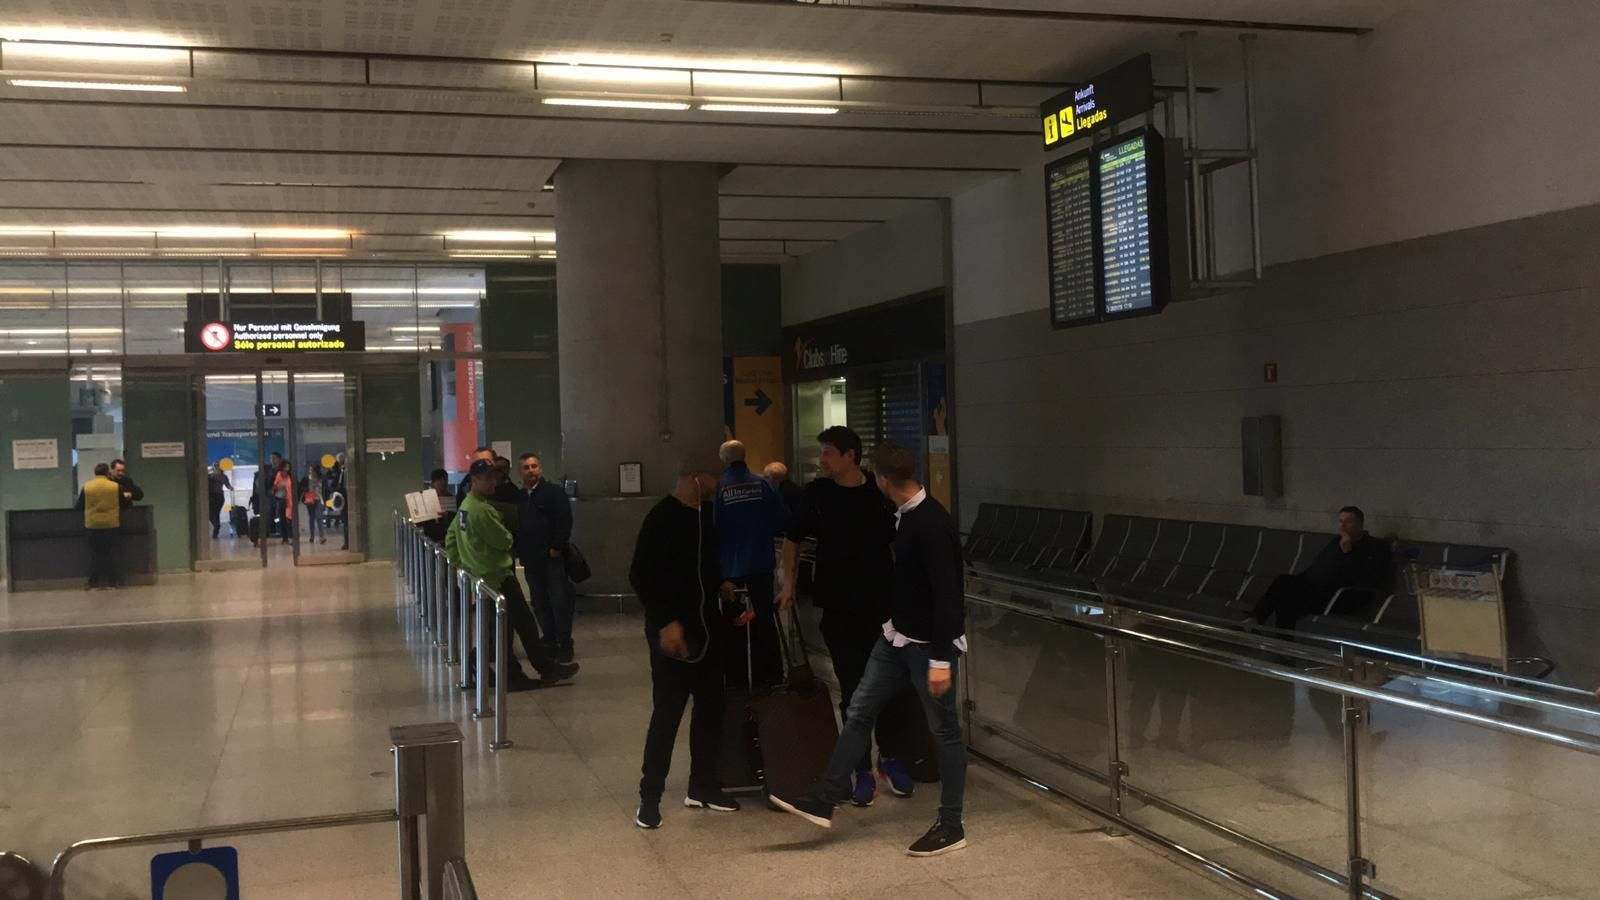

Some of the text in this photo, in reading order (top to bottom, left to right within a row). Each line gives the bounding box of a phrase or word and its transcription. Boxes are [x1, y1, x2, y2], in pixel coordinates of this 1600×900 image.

[1074, 84, 1094, 101] Ankunft
[1075, 99, 1095, 115] Arrivals
[1076, 110, 1107, 130] Llegadas
[233, 323, 340, 332] Nur Personal mit Genehmigung
[233, 332, 323, 340] Authorized personnel only
[234, 339, 344, 350] Sólo personal autorizado
[803, 343, 848, 369] Clubs Hire
